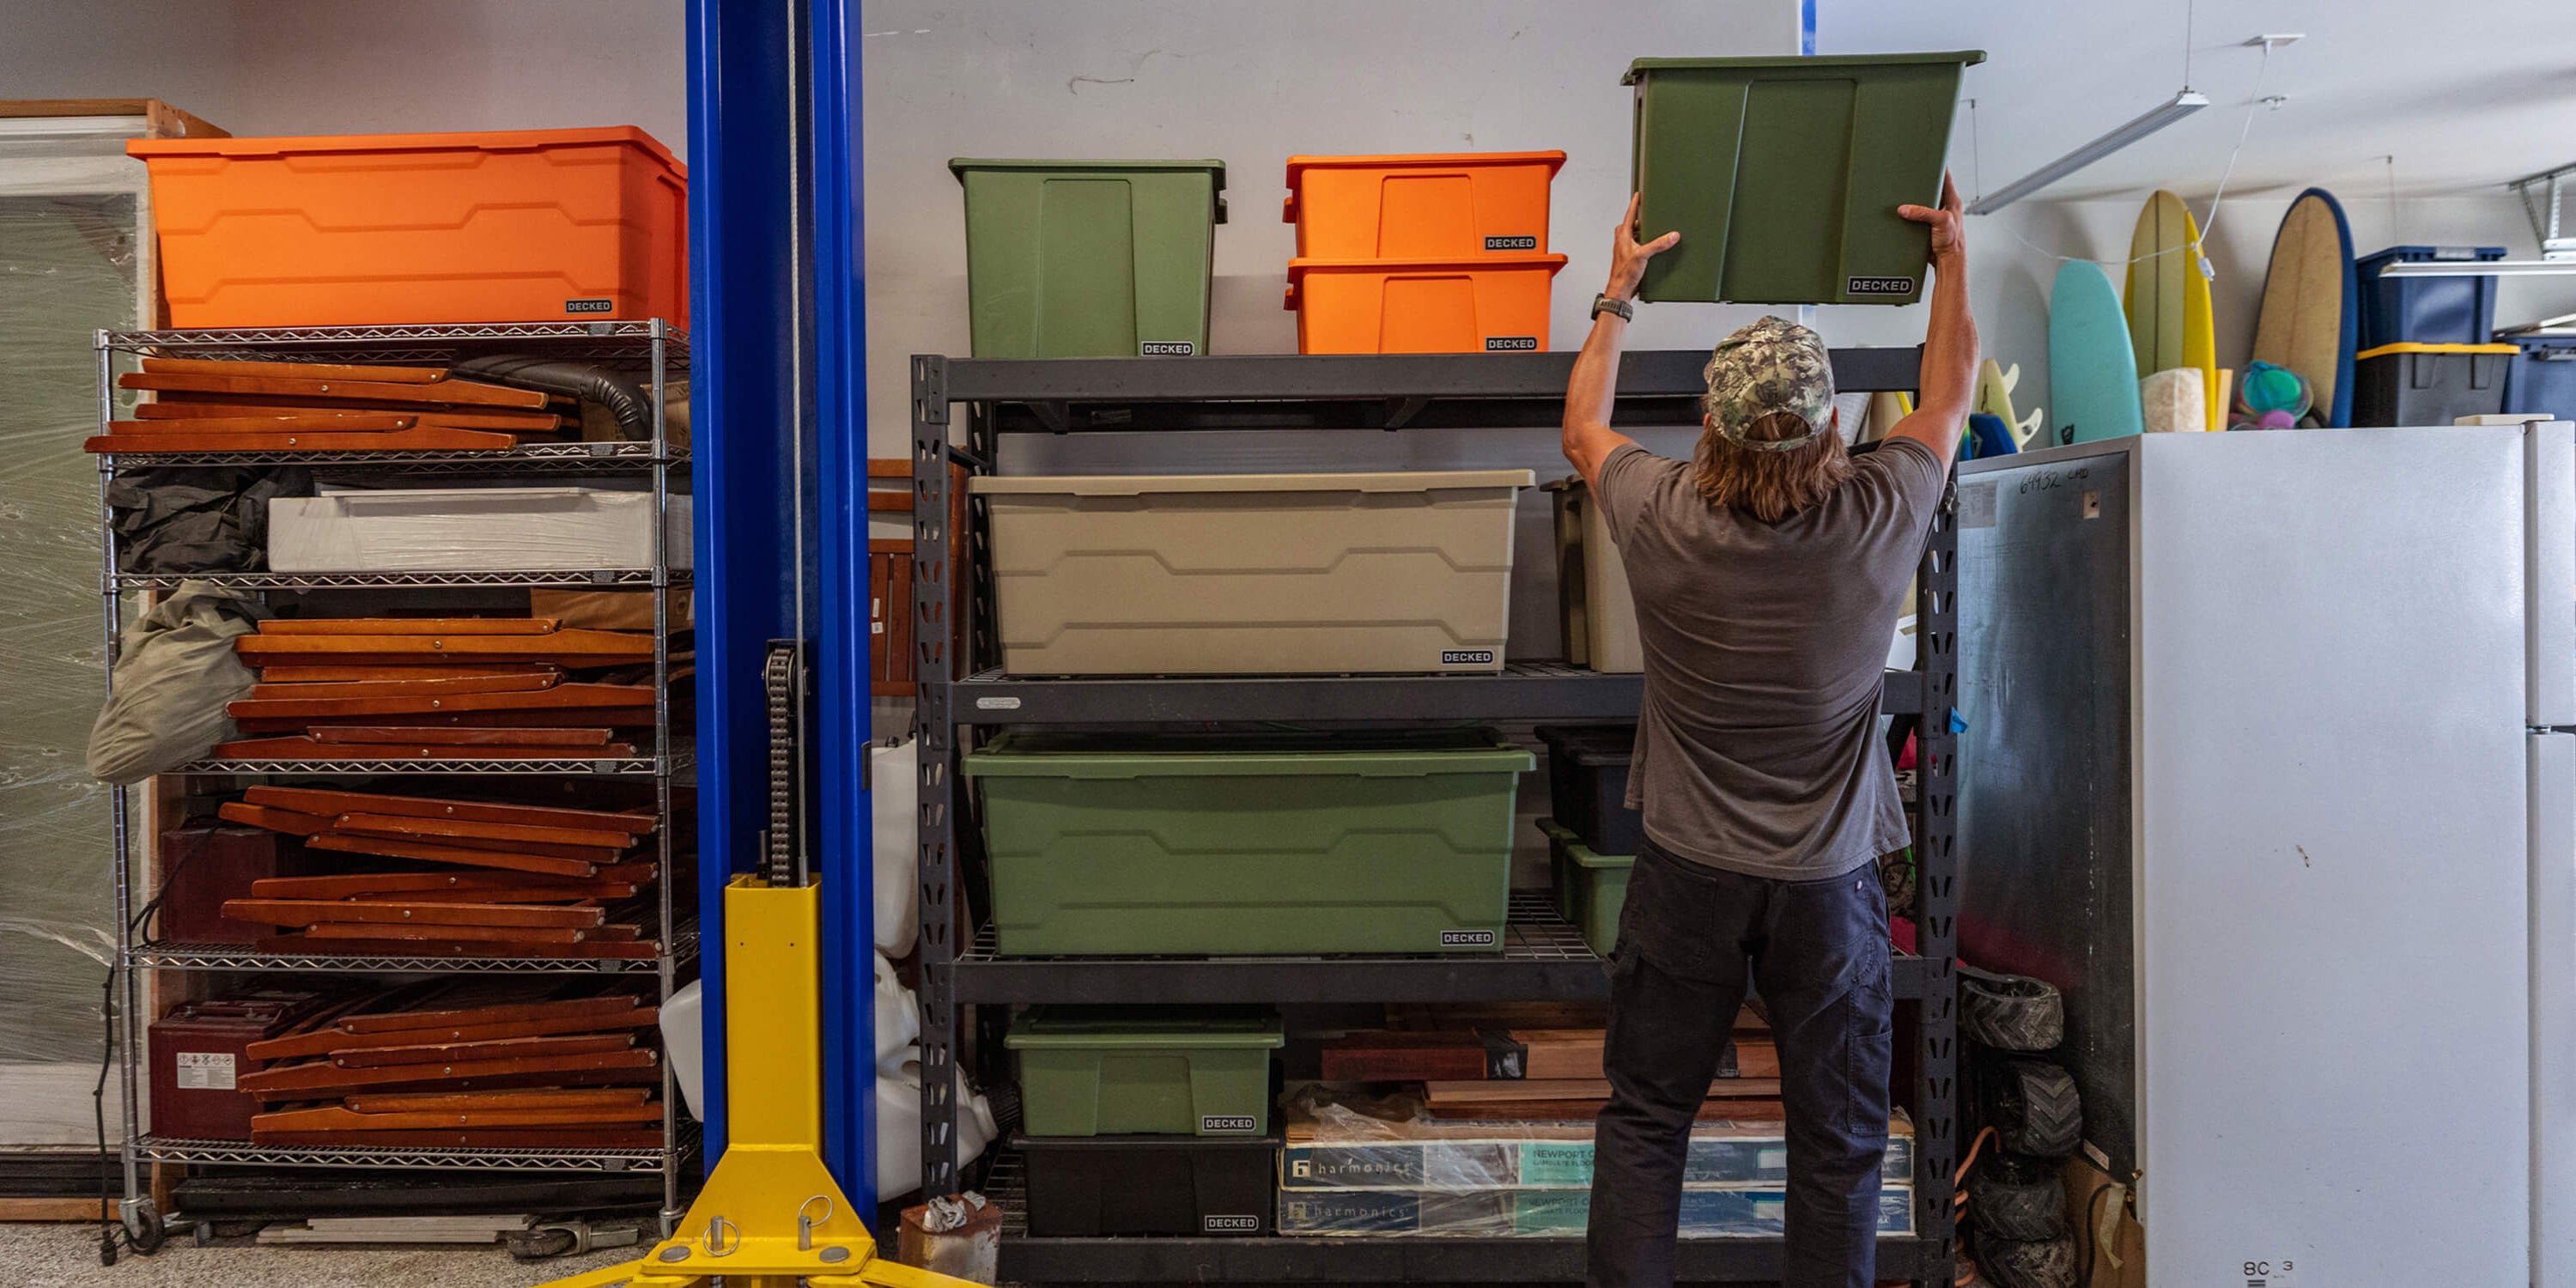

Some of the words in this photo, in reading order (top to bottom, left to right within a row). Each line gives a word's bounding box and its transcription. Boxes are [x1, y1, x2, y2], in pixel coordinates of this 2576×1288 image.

[1487, 238, 1534, 248] DECKED
[1851, 280, 1910, 292] DECKED
[568, 301, 611, 312] DECKED
[1488, 338, 1535, 349] DECKED
[1145, 344, 1192, 354] DECKED
[1444, 652, 1492, 662] DECKED
[1444, 933, 1492, 944] DECKED
[1206, 1119, 1253, 1128] DECKED
[1533, 1149, 1586, 1159] NEWPORT
[1318, 1162, 1409, 1175] harmonics
[1314, 1204, 1405, 1218] harmonics
[1208, 1218, 1255, 1228] DECKED
